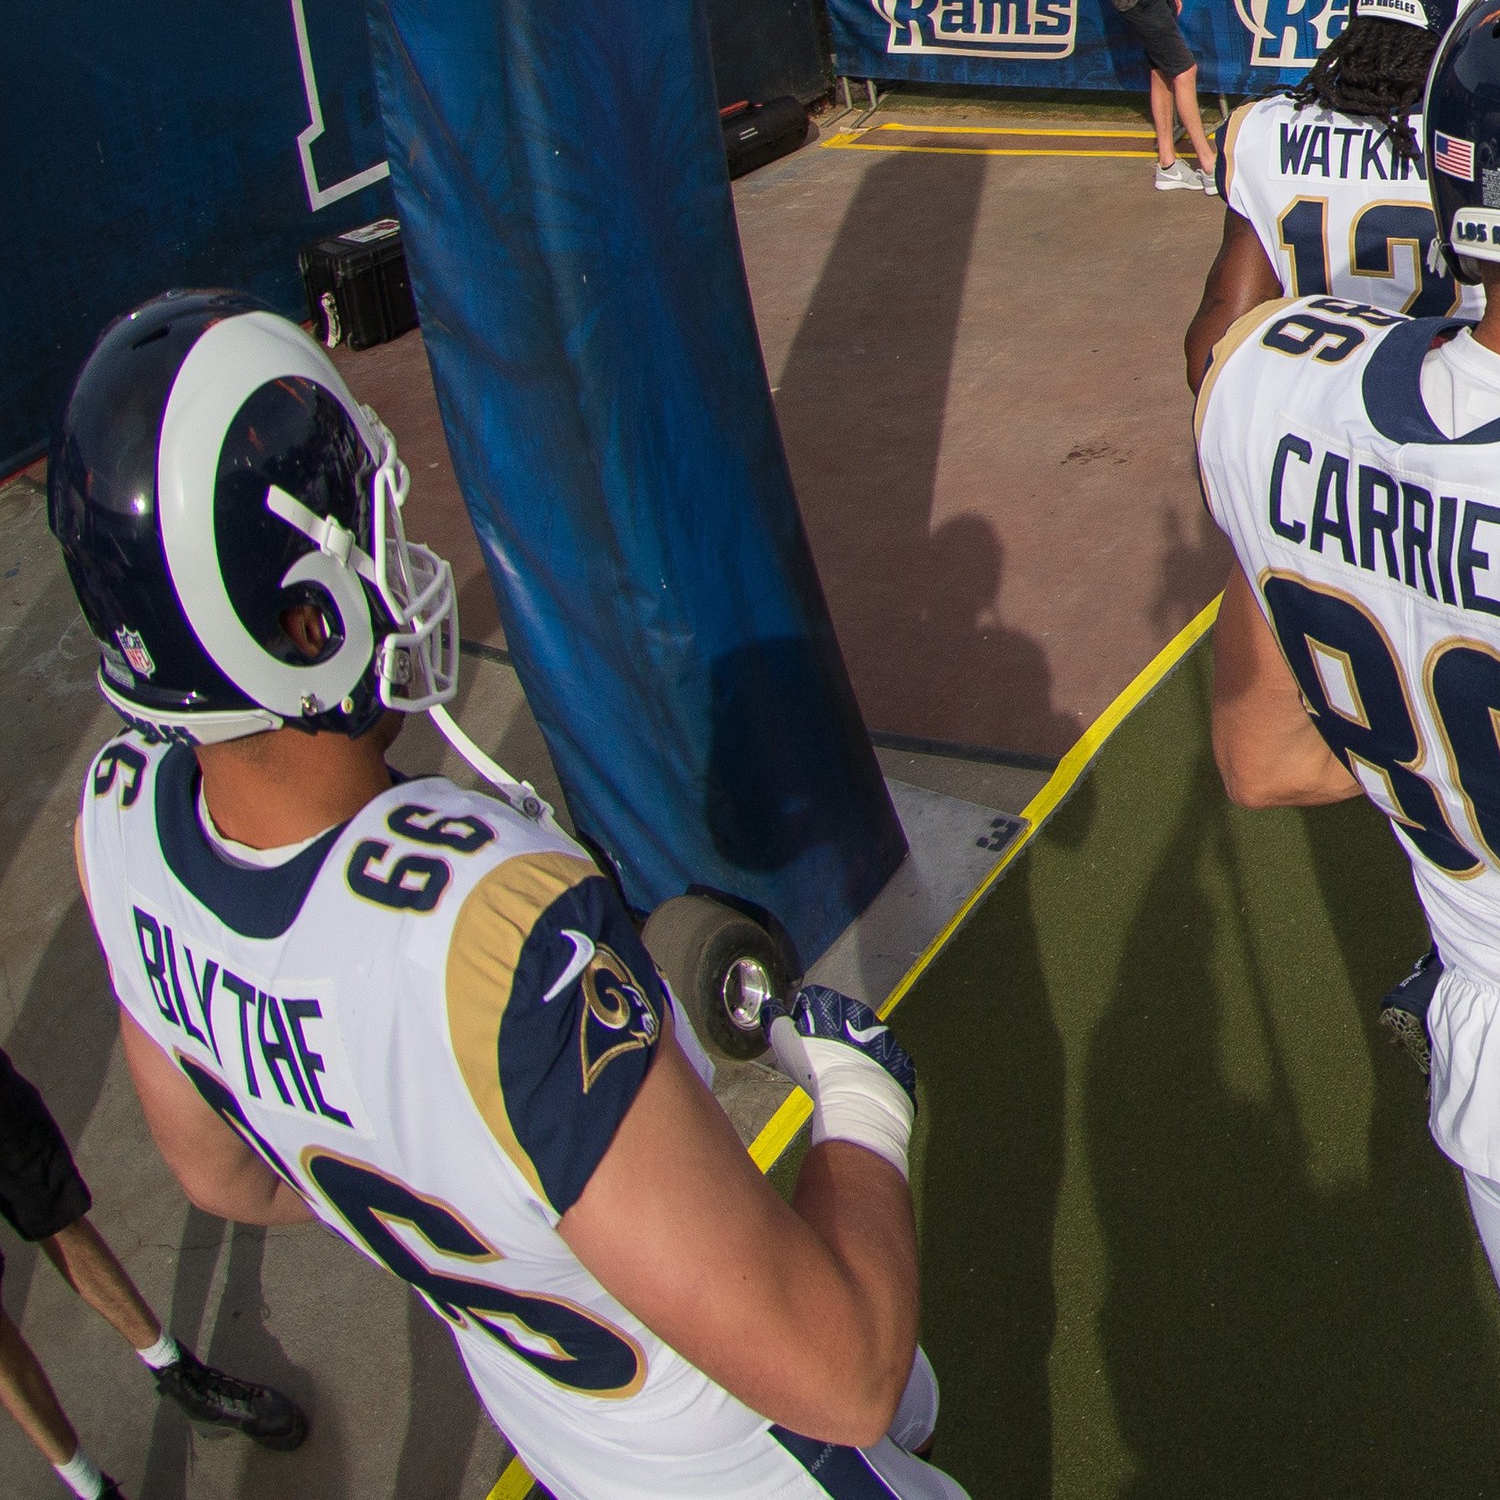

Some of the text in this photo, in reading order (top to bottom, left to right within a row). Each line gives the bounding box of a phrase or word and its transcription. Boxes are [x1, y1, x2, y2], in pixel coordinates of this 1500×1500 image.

[1278, 121, 1428, 181] WATKIN
[1456, 220, 1488, 243] LOS
[344, 802, 502, 916] 66
[133, 904, 355, 1130] BLYTHE
